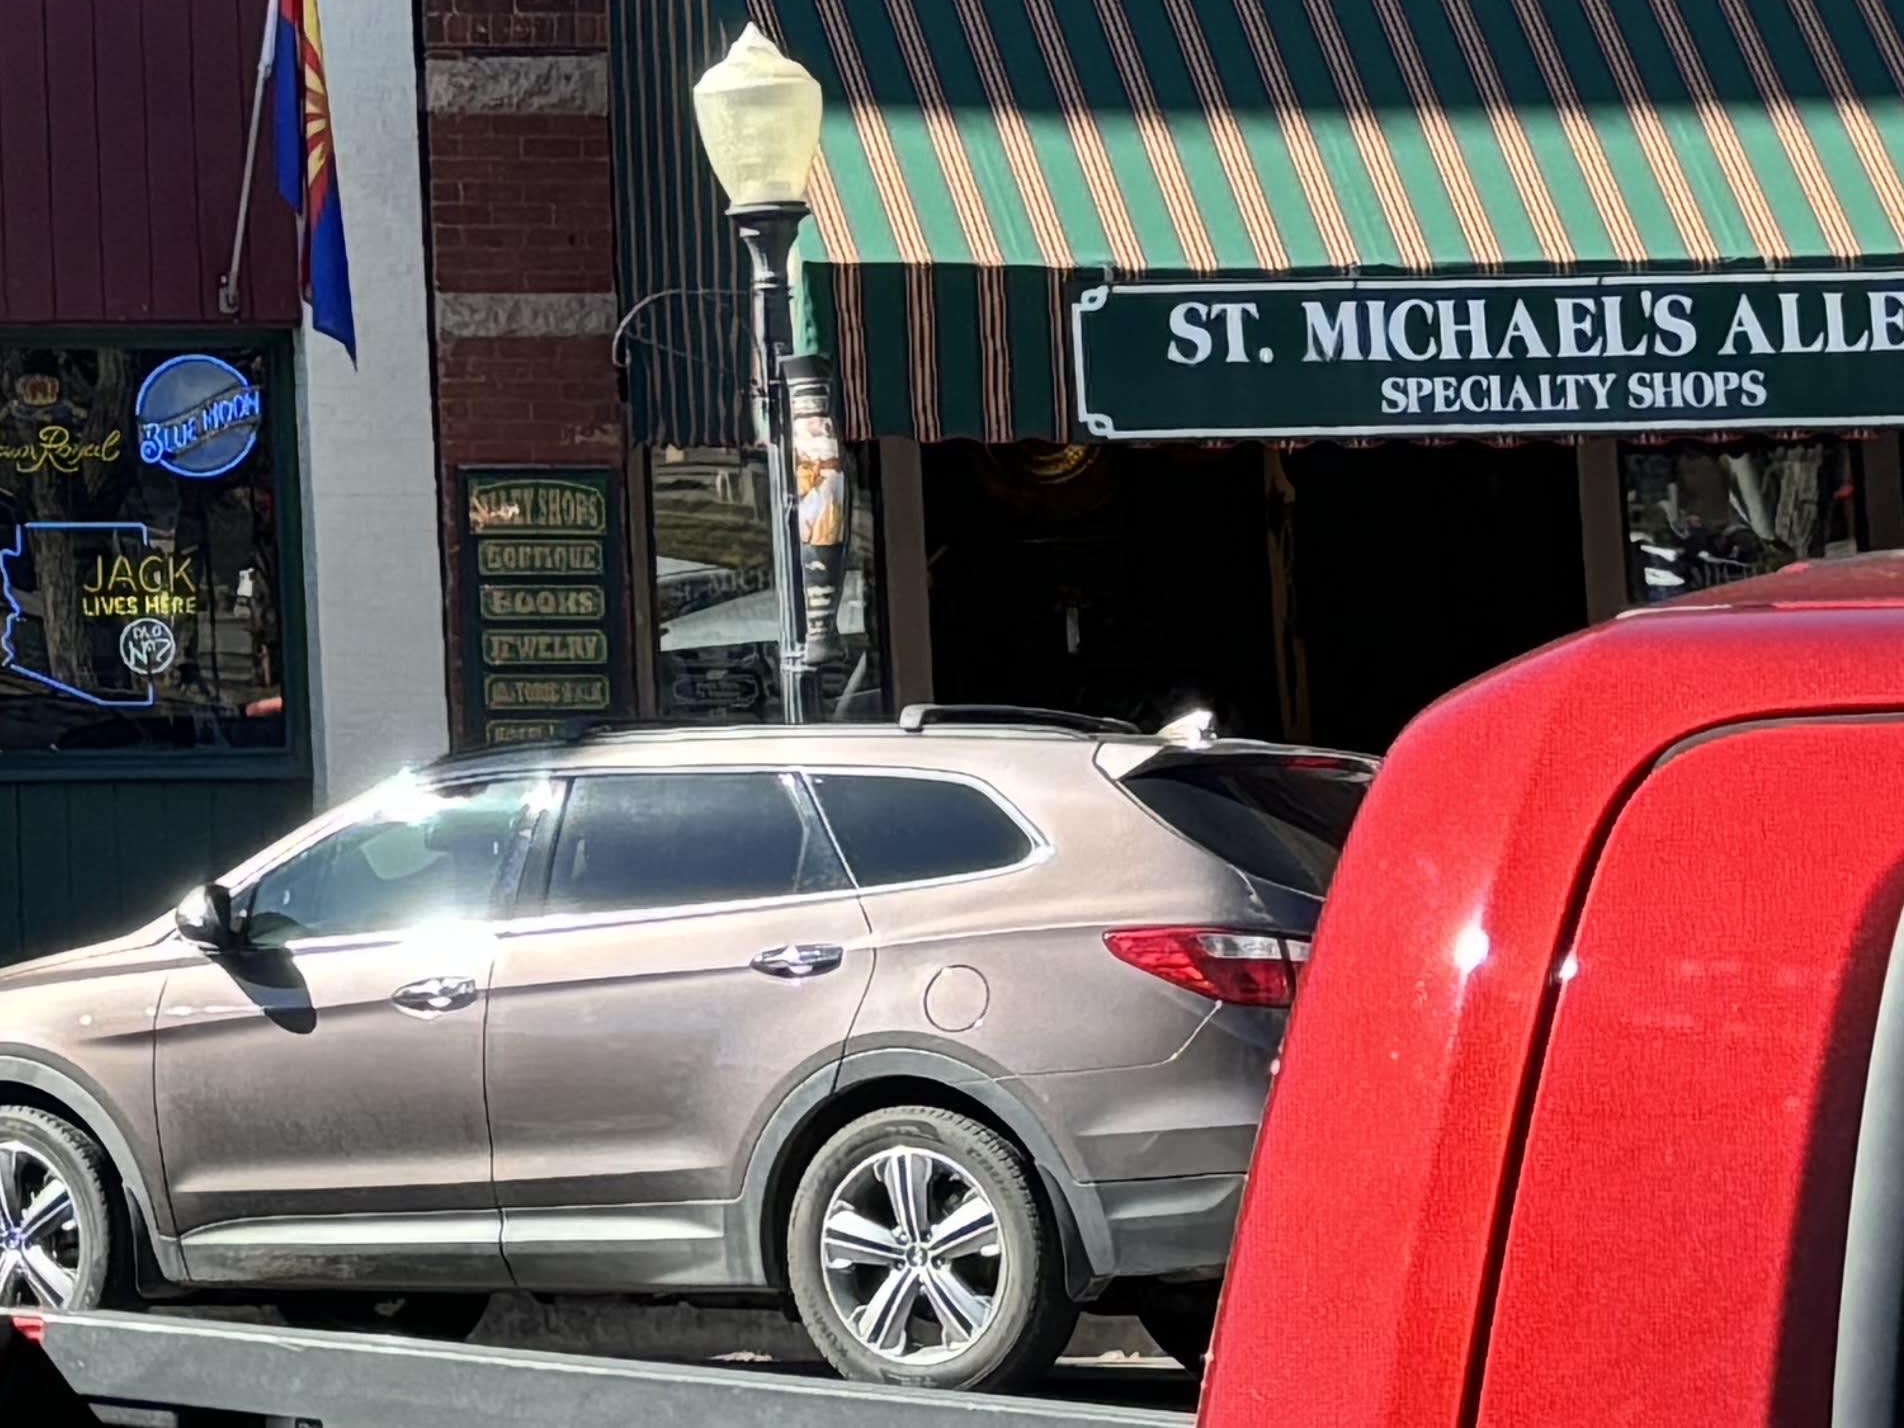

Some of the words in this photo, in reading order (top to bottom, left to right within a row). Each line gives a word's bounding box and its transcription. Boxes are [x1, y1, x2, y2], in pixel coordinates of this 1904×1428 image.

[1166, 300, 1274, 365] ST.
[1303, 290, 1697, 363] MICHAEL'S
[1380, 371, 1617, 415] SPECIALTY
[1627, 368, 1768, 411] SHOPS
[16, 425, 121, 473] Royal
[537, 487, 598, 527] SHOPS
[83, 554, 196, 593] JACK
[82, 596, 138, 617] LIVES
[145, 595, 198, 615] HERE
[492, 590, 594, 614] BOOKS
[490, 635, 599, 659] JEWELRY
